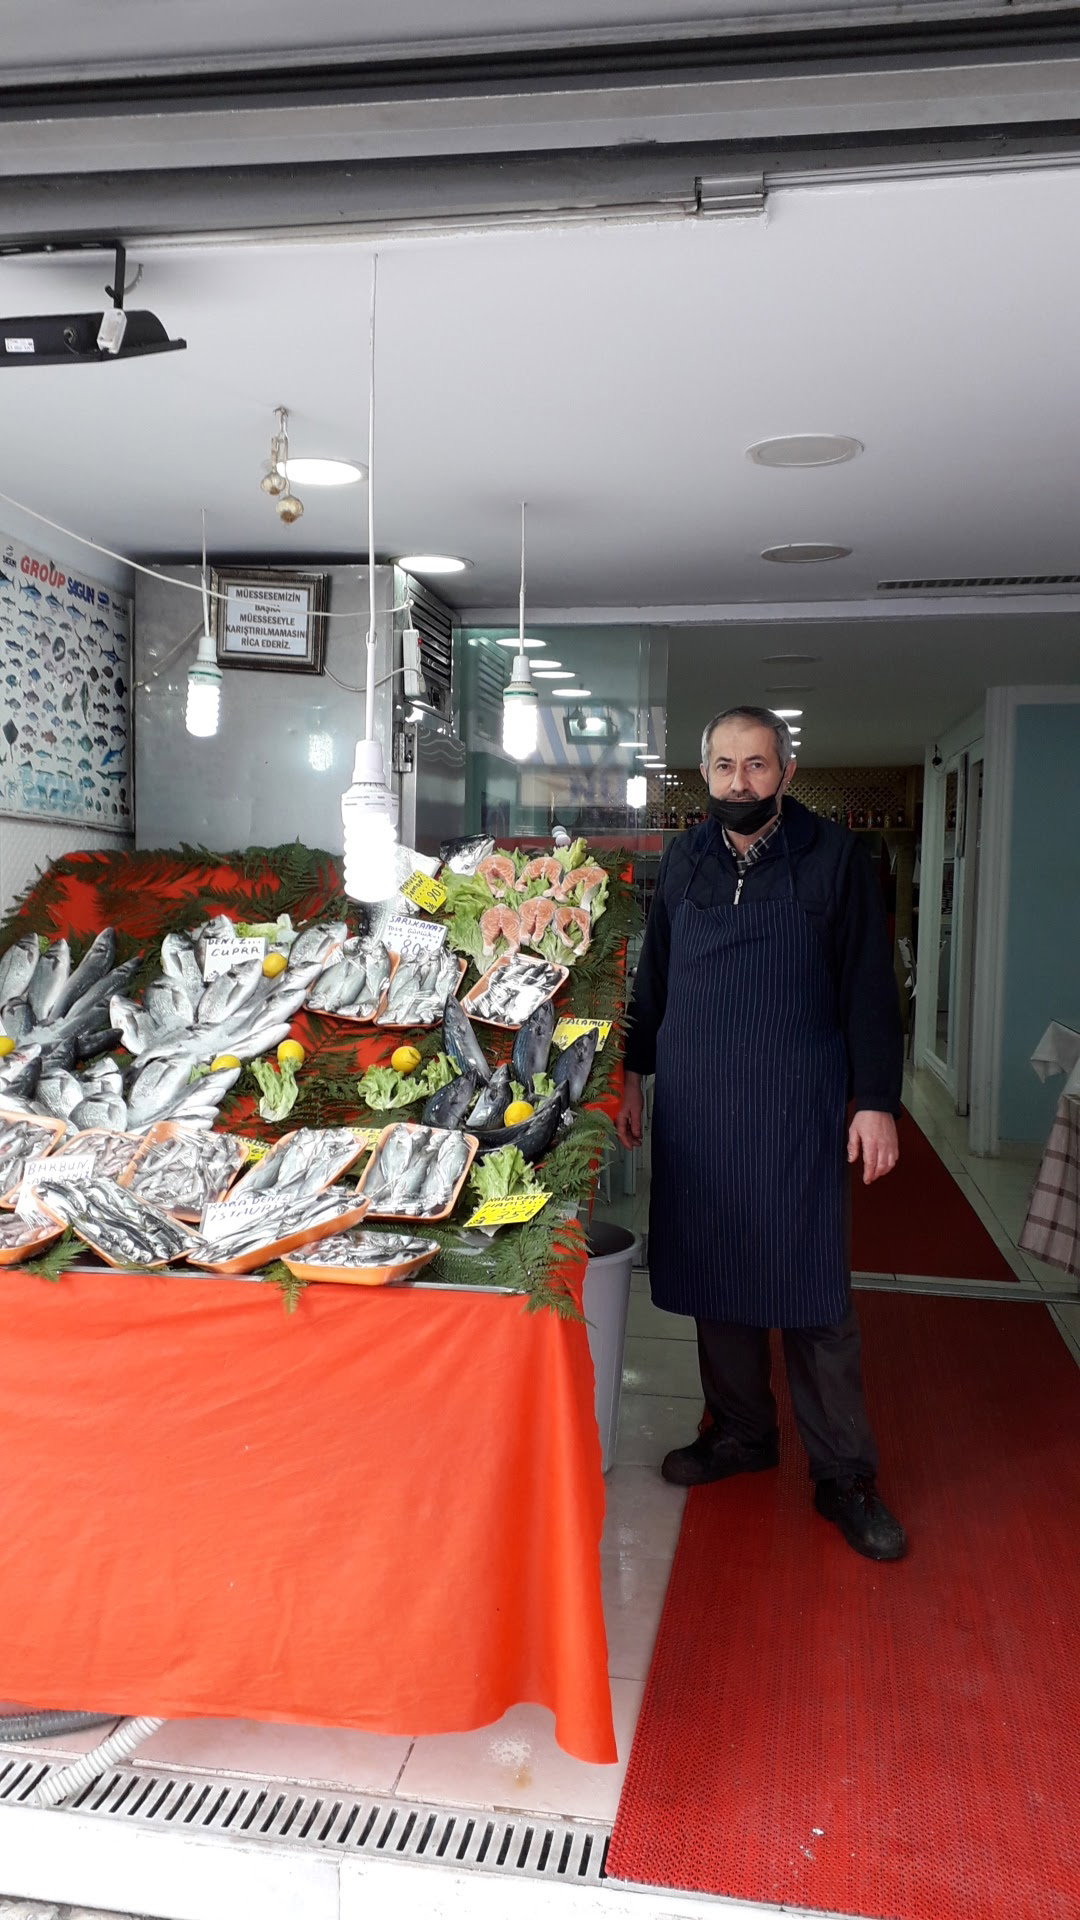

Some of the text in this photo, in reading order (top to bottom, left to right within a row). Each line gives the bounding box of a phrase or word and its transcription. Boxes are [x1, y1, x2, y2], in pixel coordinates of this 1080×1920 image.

[20, 555, 66, 588] GROUP
[235, 588, 301, 603] MÜESSESEMİZİN
[239, 613, 295, 626] MÜESSESEYLE
[241, 636, 260, 647] RİCA
